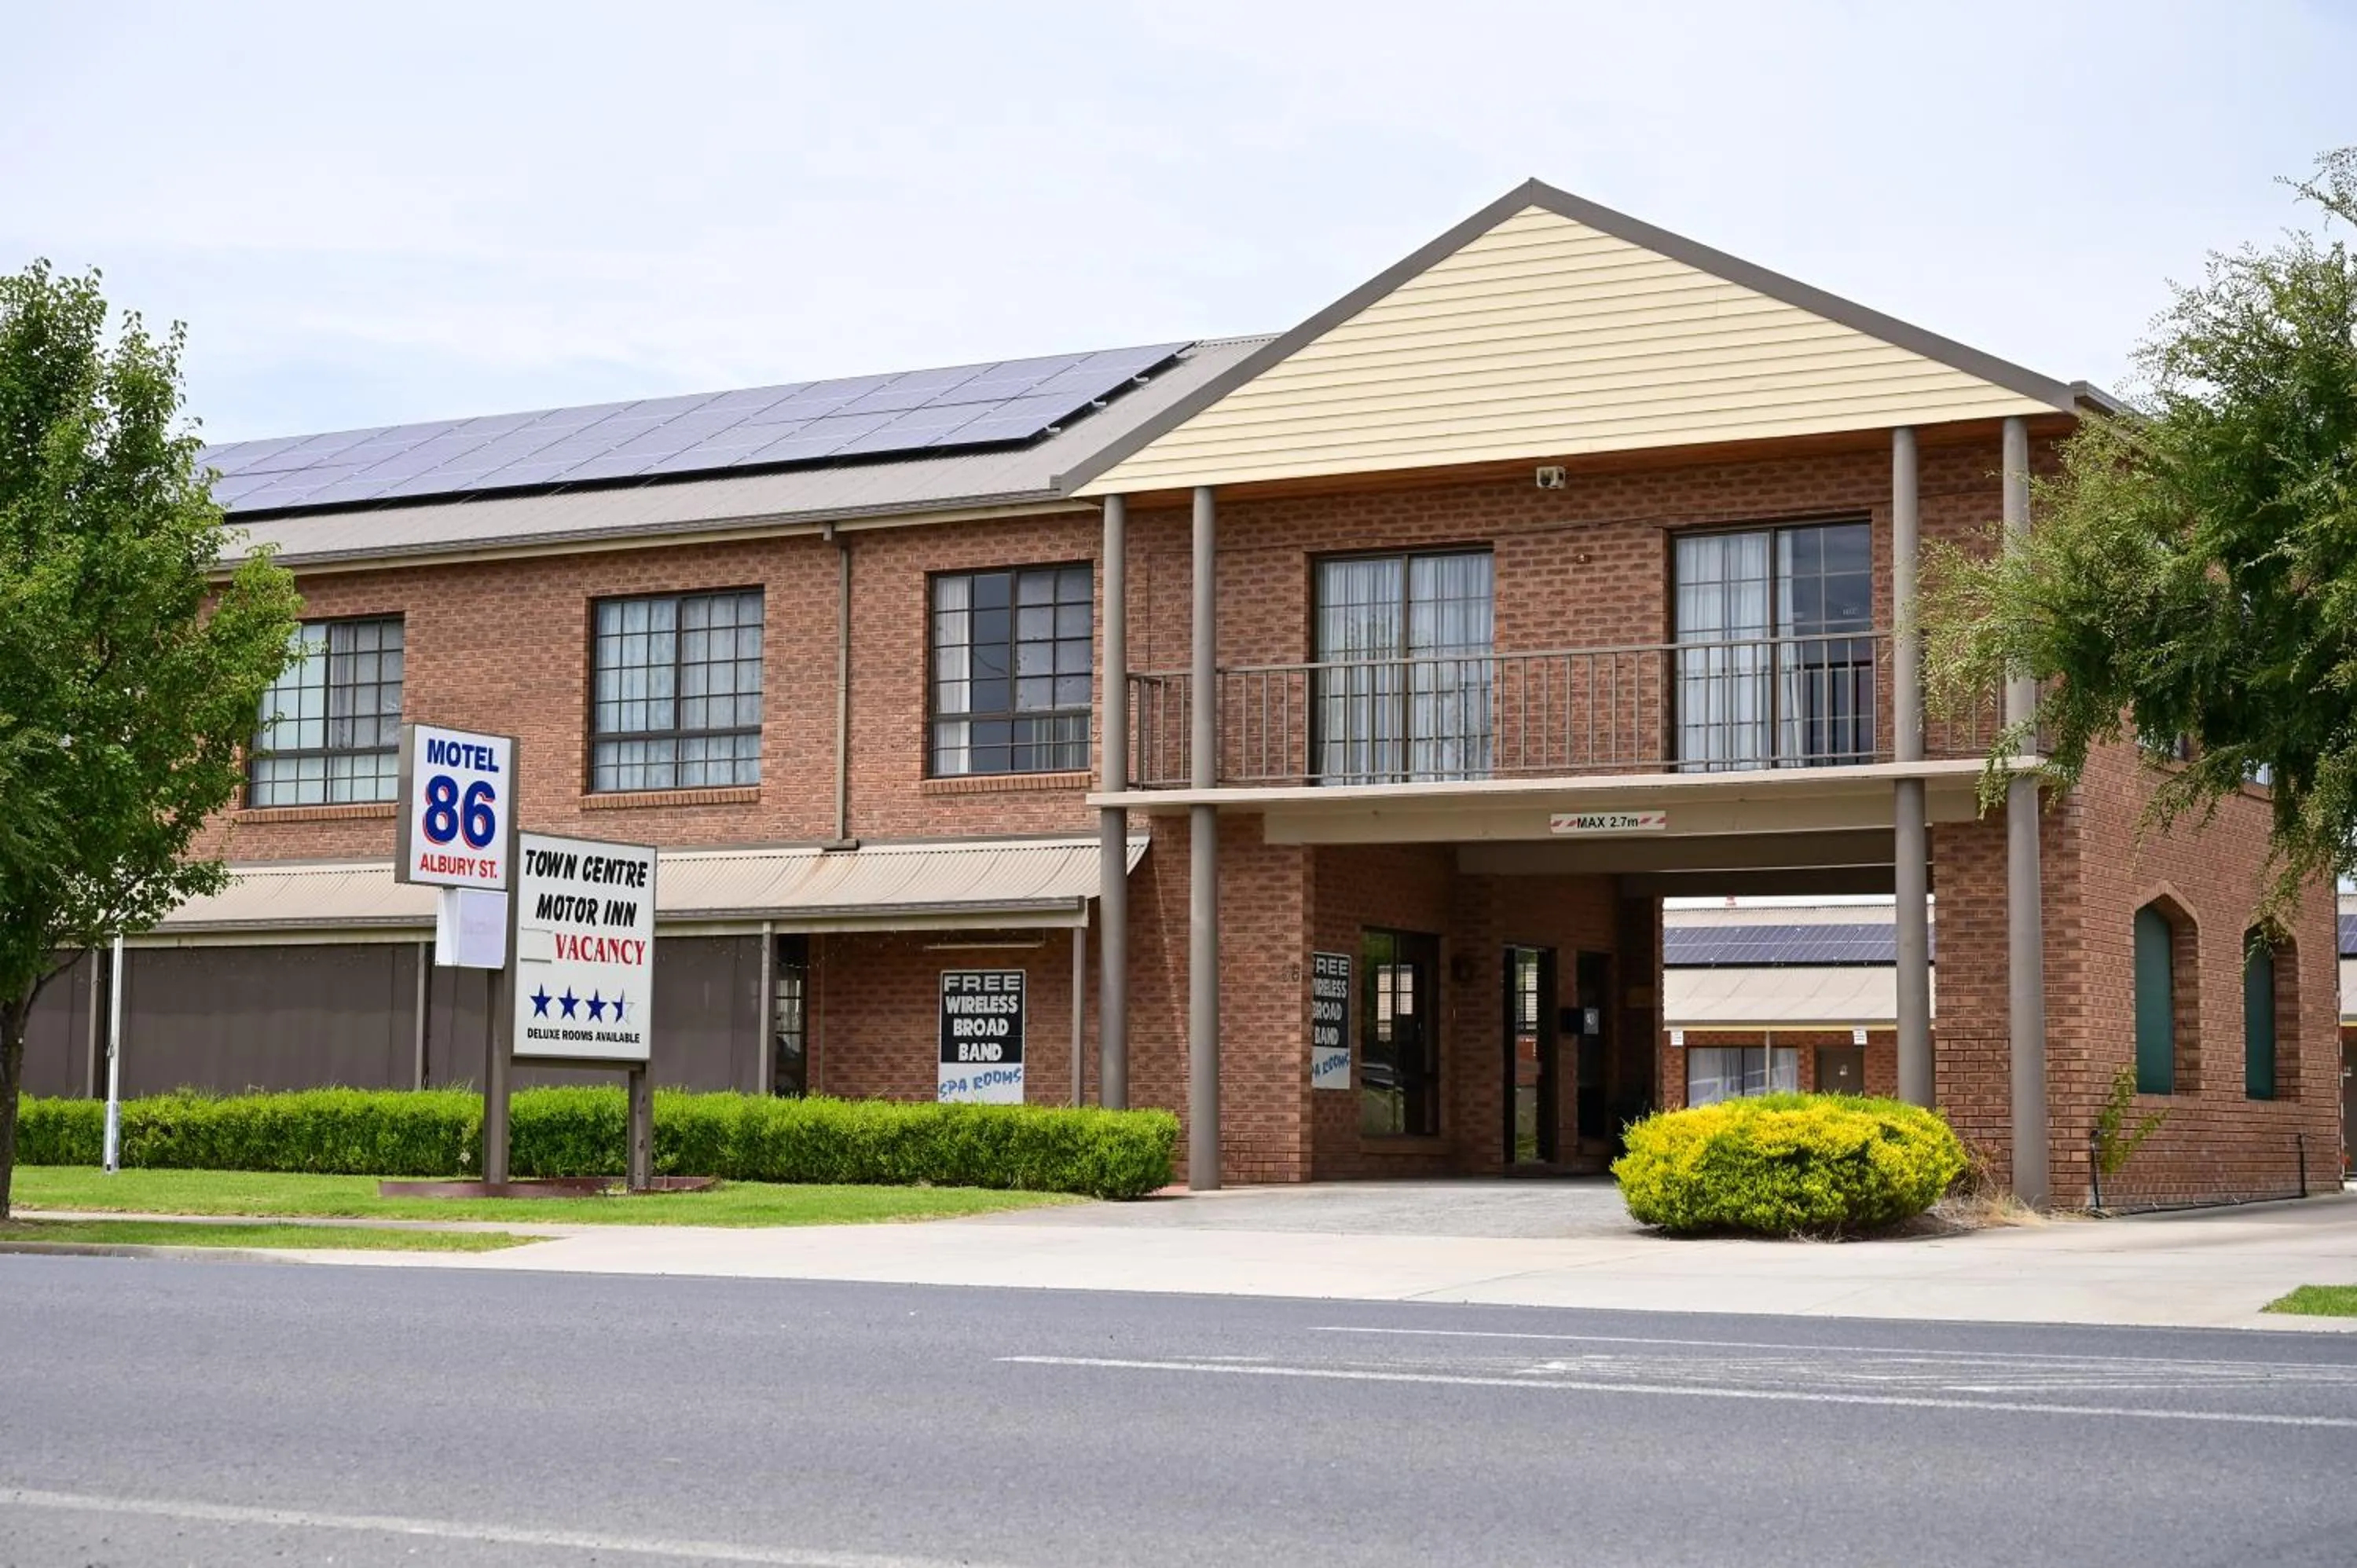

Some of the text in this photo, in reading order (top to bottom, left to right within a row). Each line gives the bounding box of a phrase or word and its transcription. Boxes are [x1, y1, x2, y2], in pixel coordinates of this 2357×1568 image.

[427, 738, 499, 773] MOTEL
[423, 775, 496, 850] 86
[1577, 816, 1638, 829] MAX 2.7m
[420, 852, 497, 879] ALBURY ST.
[526, 849, 648, 888] TOWN CENTRE
[536, 893, 637, 928] MOTOR INN
[555, 932, 646, 965] VACANCY
[1313, 957, 1349, 976] REE
[944, 974, 1021, 992] FREE
[945, 995, 1018, 1014] WIRELESS
[527, 1027, 640, 1044] DELUXE ROOMS AVAILABLE
[953, 1017, 1010, 1037] BROAD
[1314, 1025, 1340, 1046] BAND
[958, 1042, 1003, 1061] BAND
[940, 1067, 1022, 1097] SPA ROOMS
